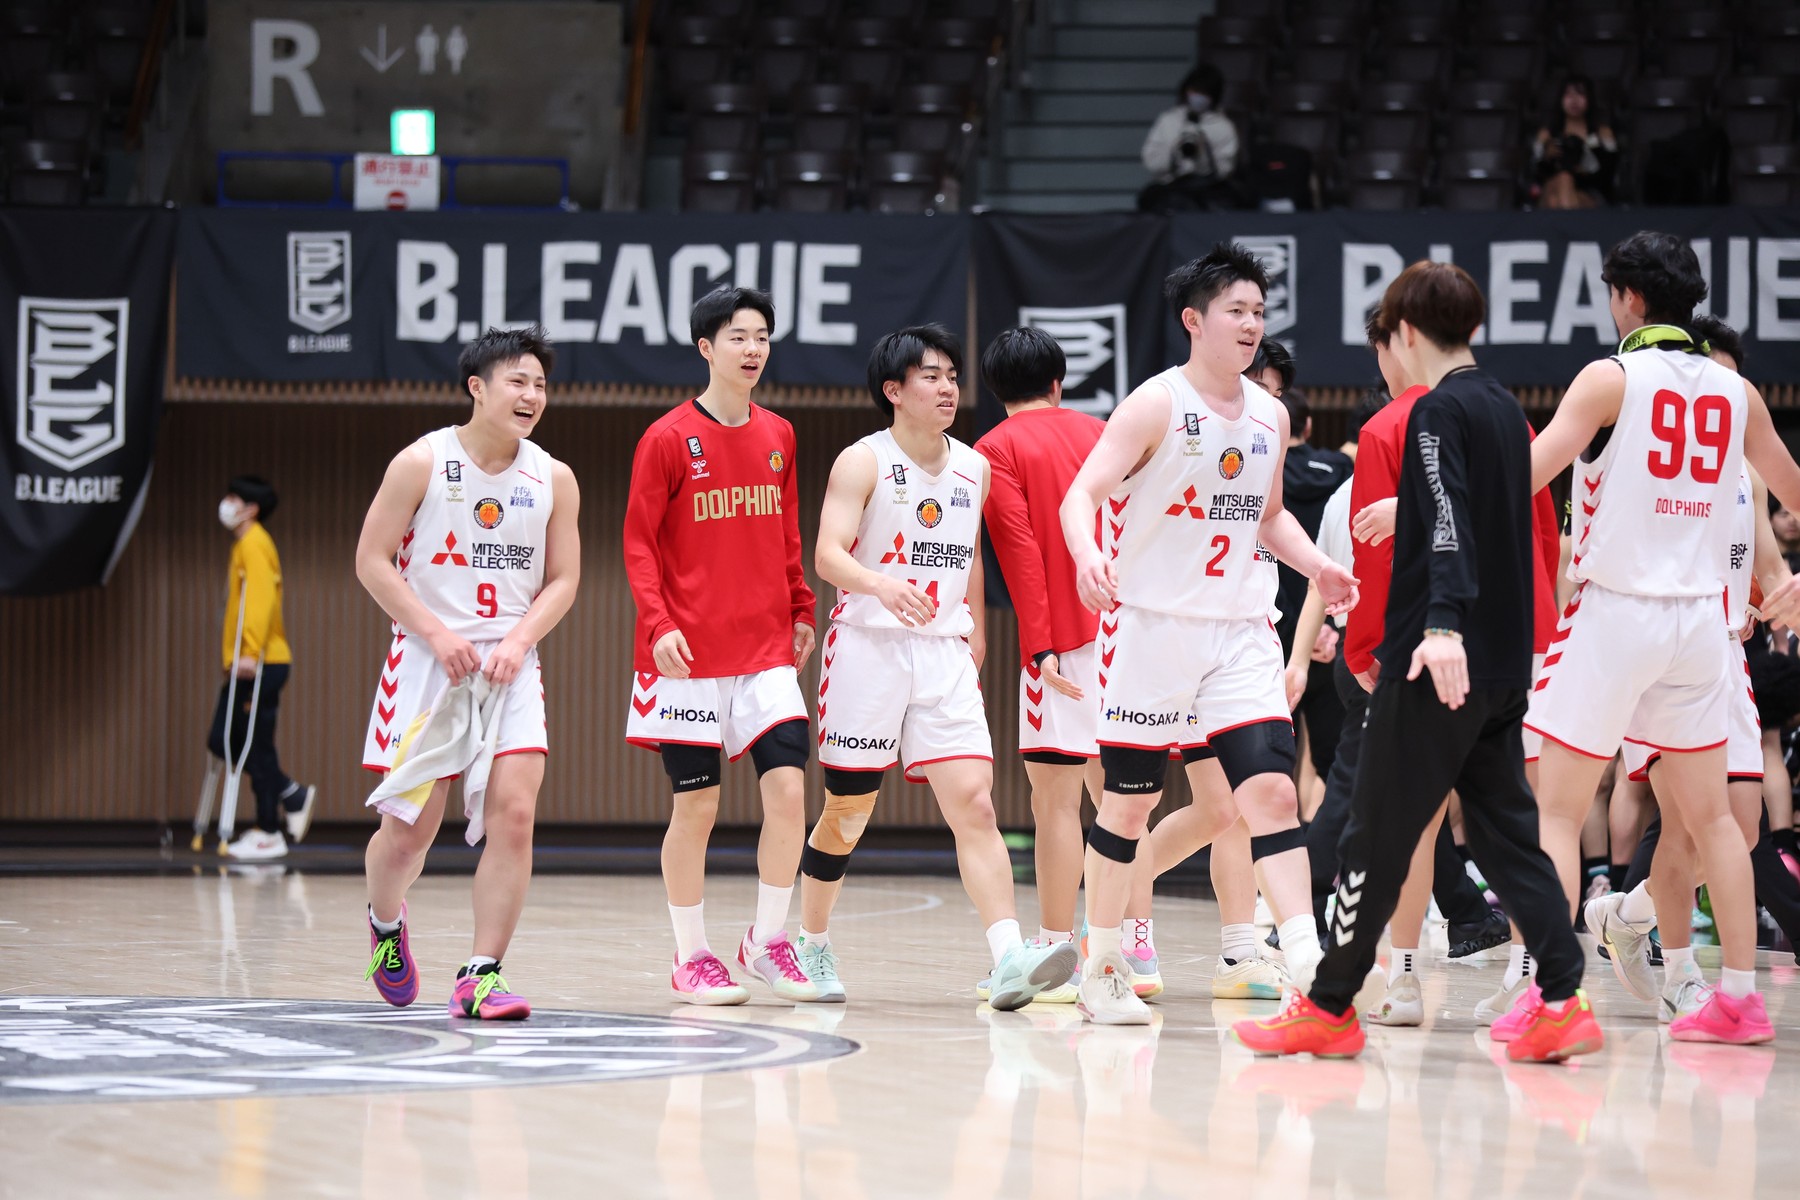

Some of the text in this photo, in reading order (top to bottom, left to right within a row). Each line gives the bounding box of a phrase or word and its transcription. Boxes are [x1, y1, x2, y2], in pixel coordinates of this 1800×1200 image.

[250, 19, 325, 117] R
[1647, 389, 1732, 484] 99
[15, 473, 123, 504] B.LEAGUE
[1655, 498, 1712, 518] DOLPHINS
[912, 541, 973, 559] MITSUBISHI
[1205, 535, 1231, 577] 2
[472, 556, 532, 570] ELECTRIC
[911, 554, 966, 570] ELECTRIC
[476, 583, 498, 618] 9
[674, 708, 719, 723] HOSA
[1121, 710, 1179, 726] HOSAKA
